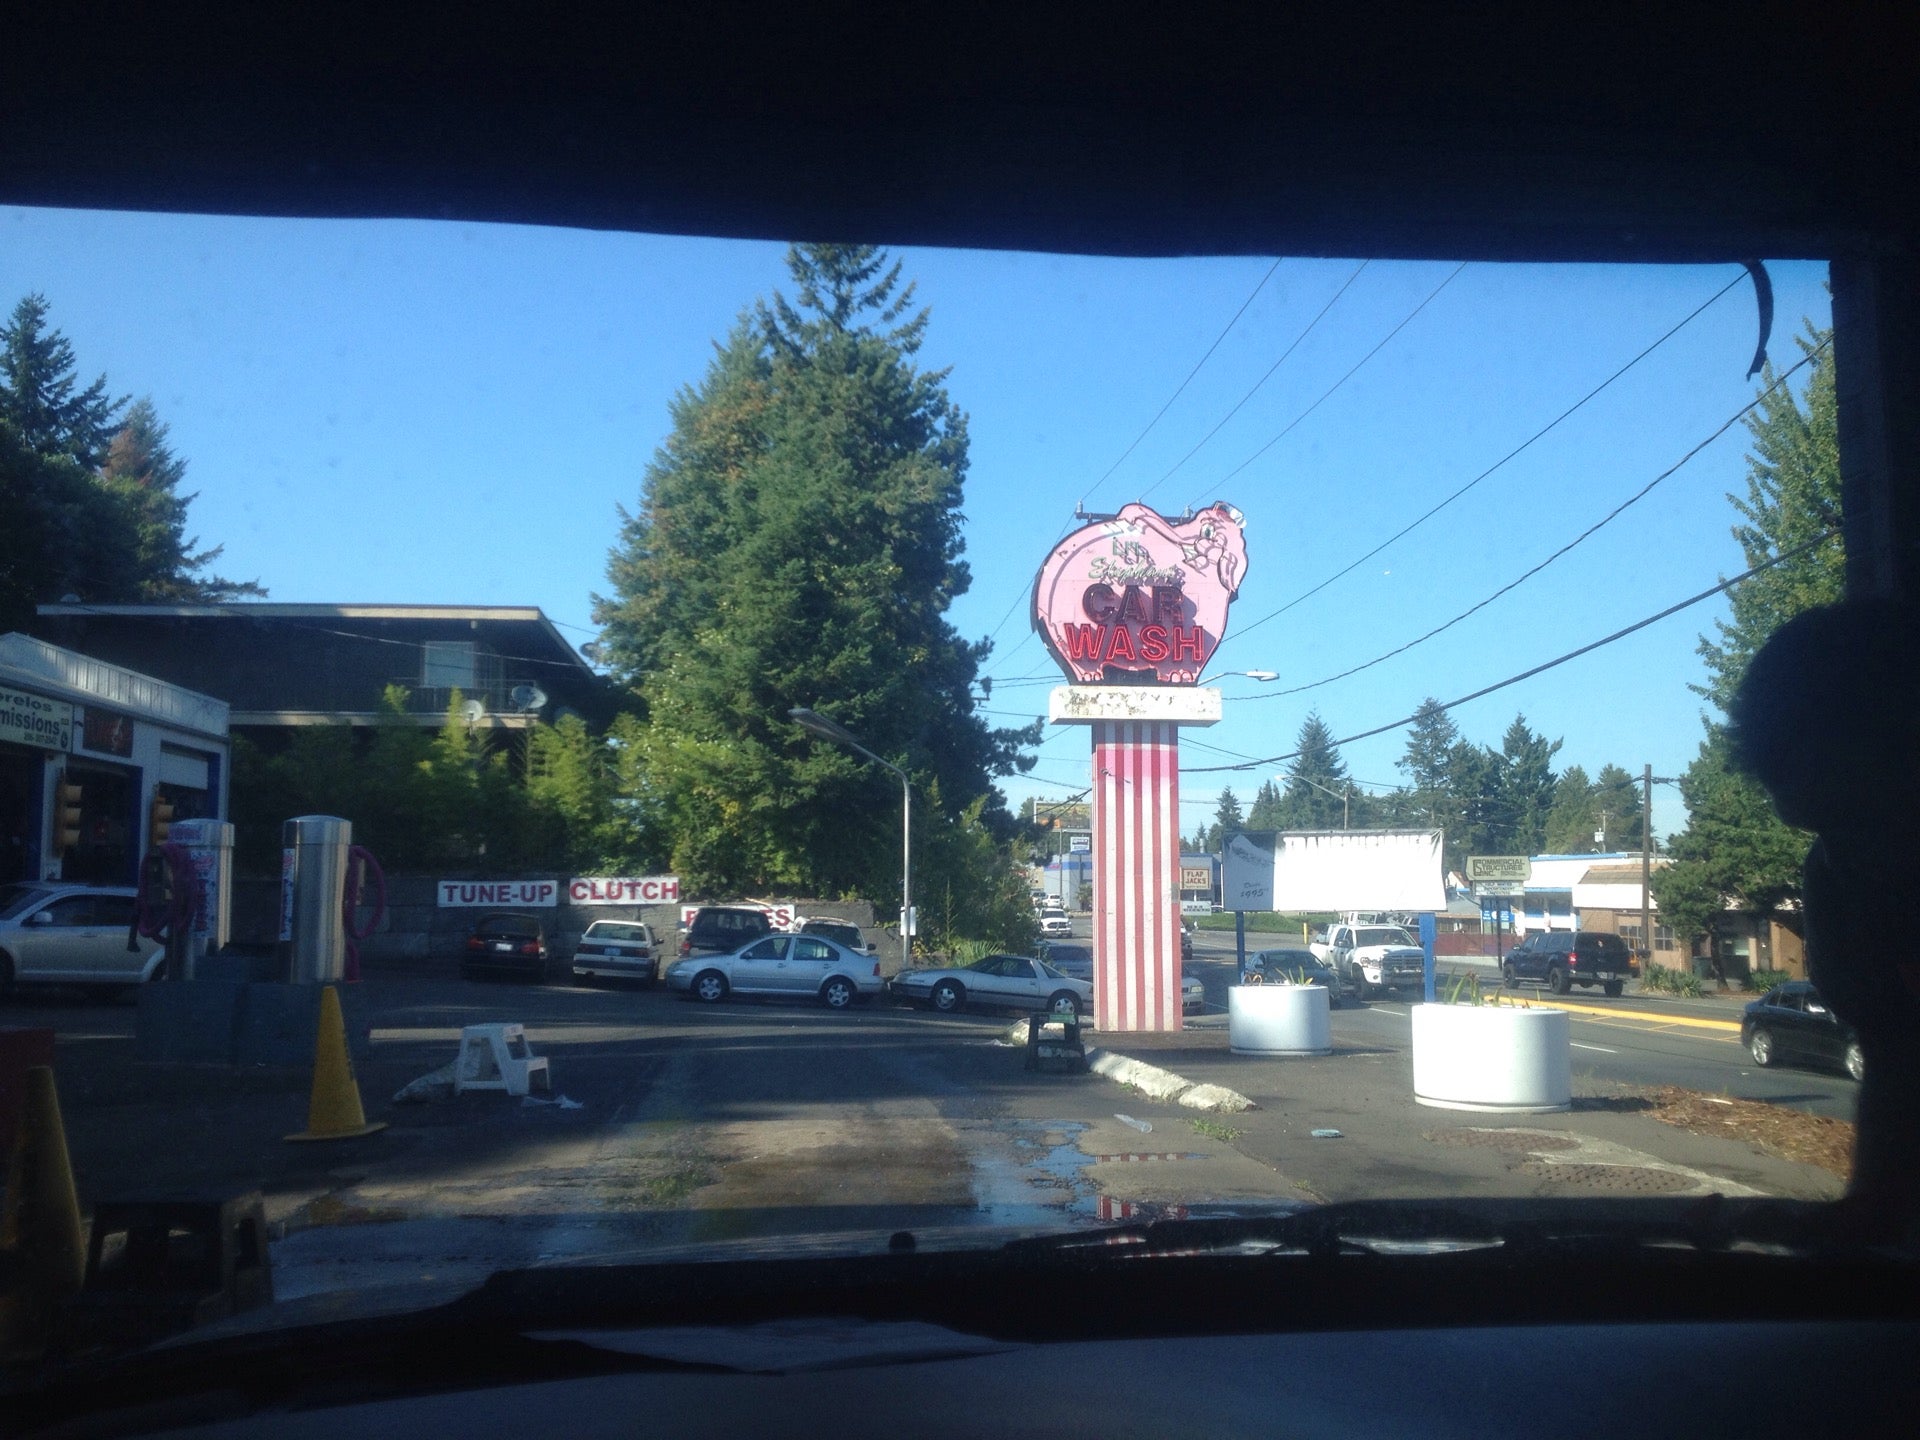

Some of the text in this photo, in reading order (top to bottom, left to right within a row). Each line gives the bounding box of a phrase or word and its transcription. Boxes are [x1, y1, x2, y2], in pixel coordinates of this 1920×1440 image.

[1082, 583, 1184, 624] CAR
[1063, 622, 1204, 661] WASH
[443, 884, 553, 903] TUNE-UP
[569, 881, 679, 900] CLUTCH
